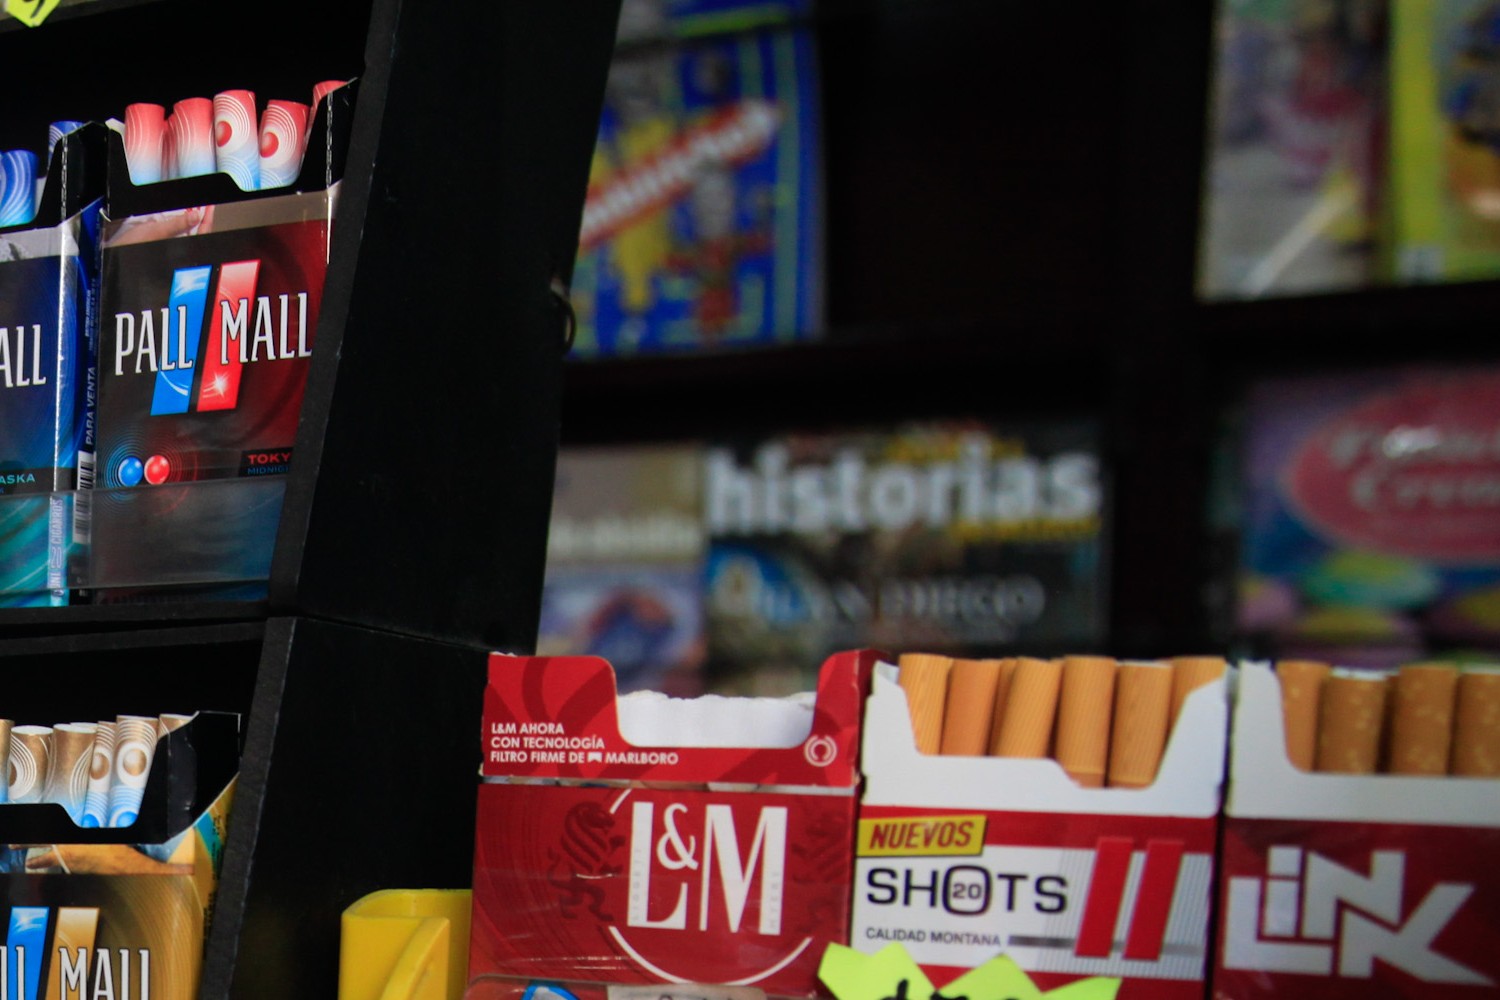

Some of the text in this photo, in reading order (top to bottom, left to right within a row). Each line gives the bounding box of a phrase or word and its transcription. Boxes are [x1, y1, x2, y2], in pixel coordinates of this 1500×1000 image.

[115, 305, 193, 375] PALL
[221, 292, 312, 365] MALL
[86, 367, 96, 445] PARA VENTA
[247, 452, 291, 465] TOKY
[247, 466, 290, 475] MIDNIG
[705, 435, 1100, 533] historias
[491, 723, 564, 734] L&M AHORA
[491, 734, 605, 749] CON TECNOLOGÍA
[490, 752, 679, 765] FILTRO FIRME DE MARLBORO
[869, 821, 975, 849] NUEVOS
[627, 801, 789, 936] L&M
[952, 882, 982, 900] 20
[865, 926, 1001, 946] CALIDAD MONTANA
